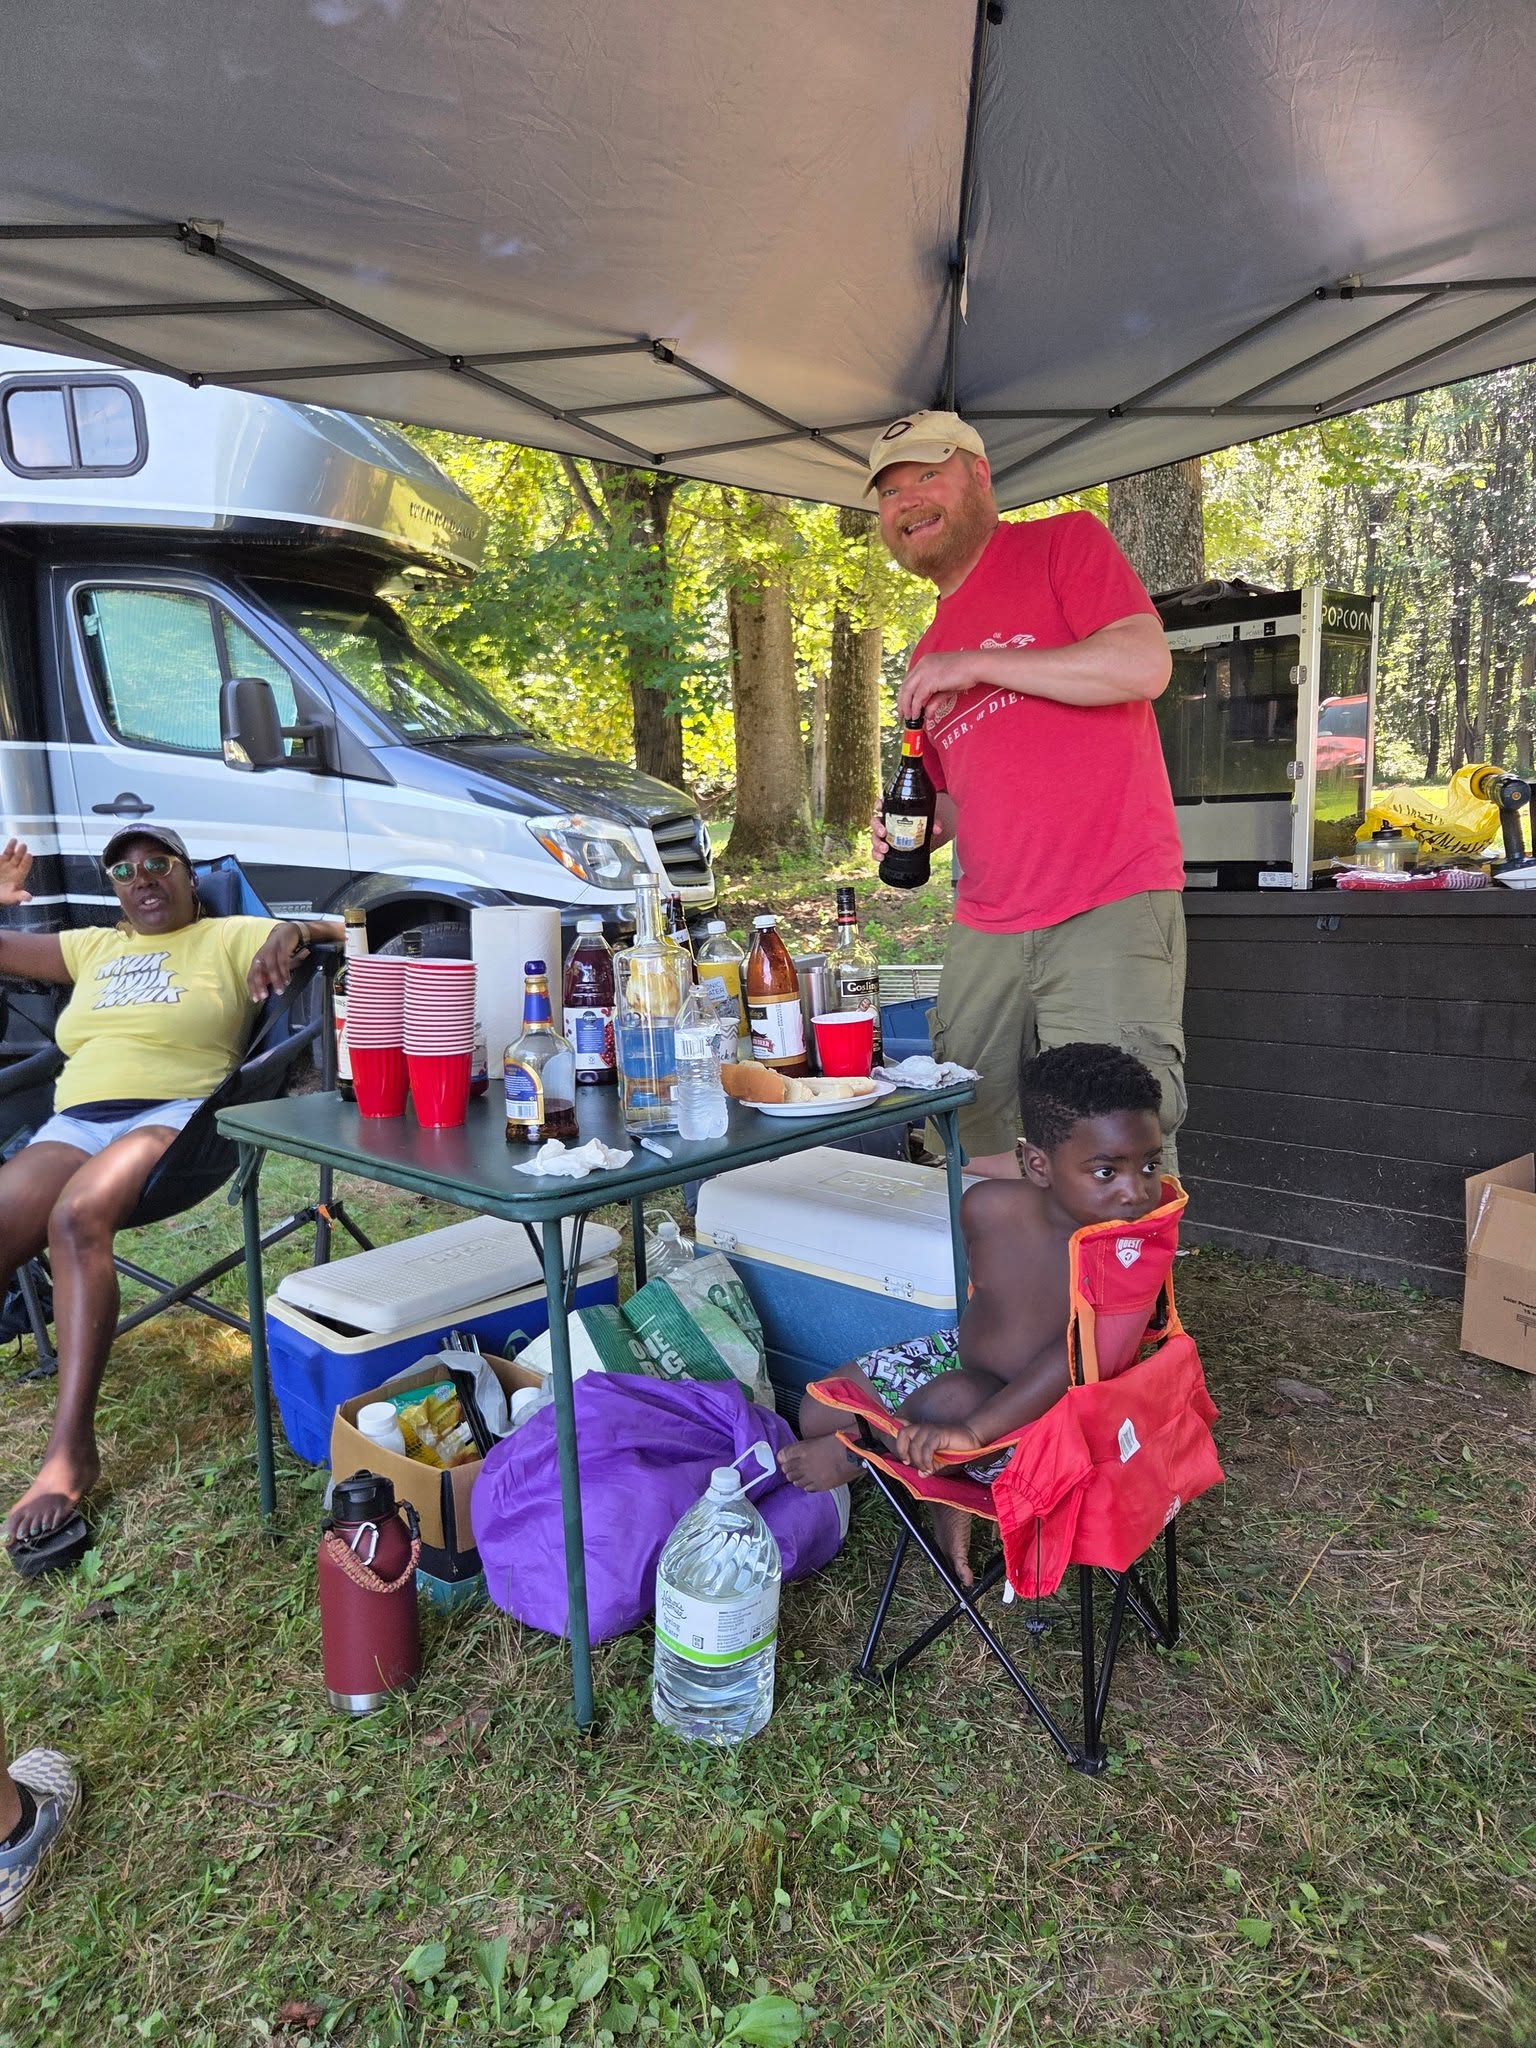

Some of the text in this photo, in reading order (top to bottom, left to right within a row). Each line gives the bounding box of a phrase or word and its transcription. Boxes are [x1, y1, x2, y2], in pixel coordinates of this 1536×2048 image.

[1321, 605, 1373, 632] POPCORN
[941, 722, 974, 750] BEER,
[988, 692, 1024, 714] DIE.
